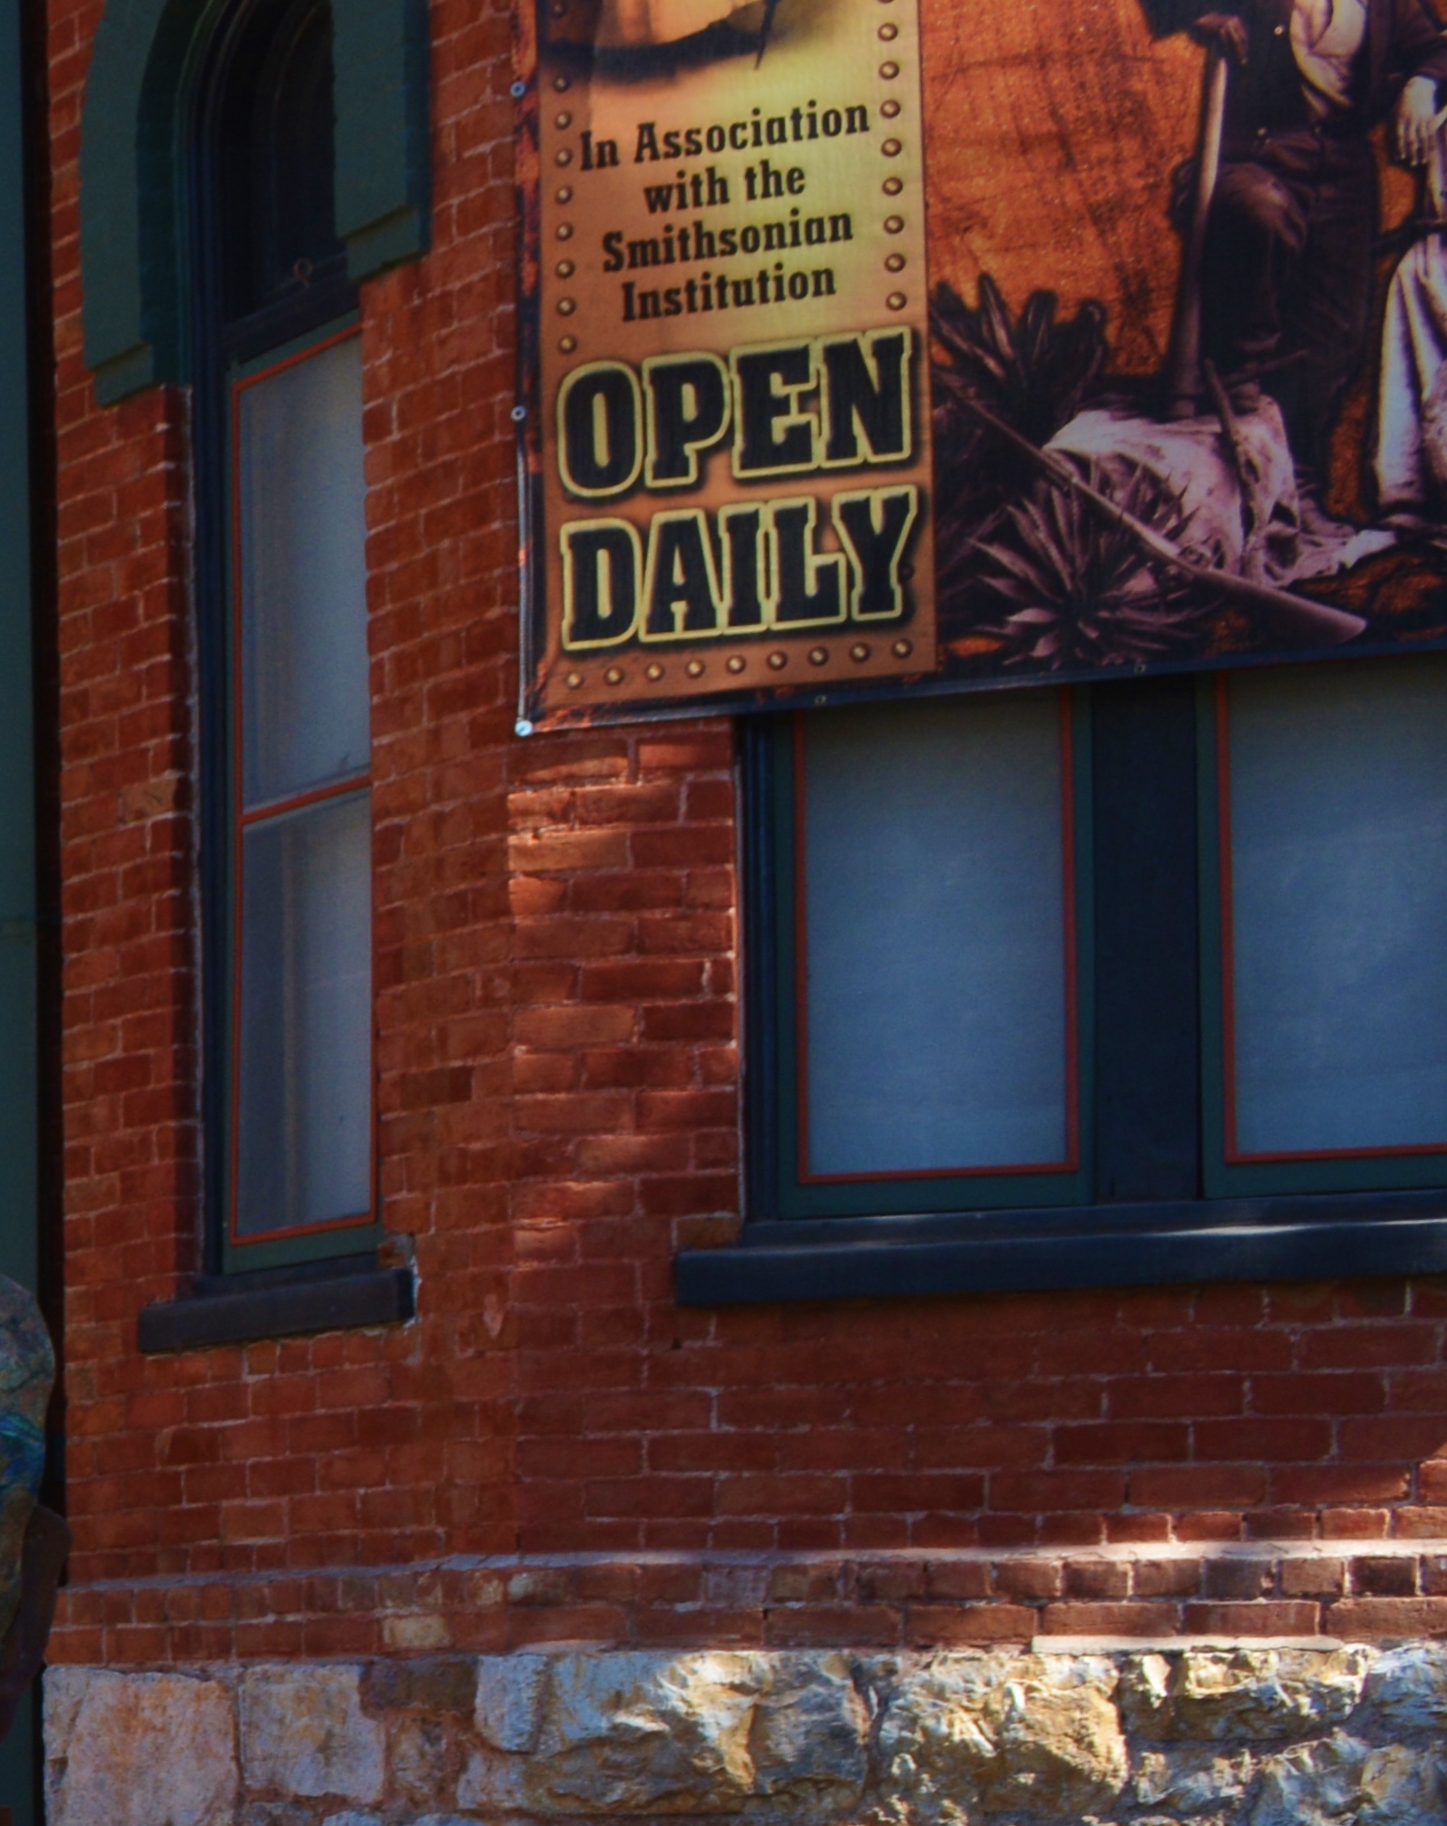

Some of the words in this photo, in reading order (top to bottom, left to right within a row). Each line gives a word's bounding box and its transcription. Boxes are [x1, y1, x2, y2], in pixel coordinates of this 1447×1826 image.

[579, 131, 620, 172] In
[633, 99, 870, 164] Association
[643, 166, 731, 214] with
[744, 159, 806, 202] the
[602, 206, 854, 273] Smithsonian
[621, 262, 837, 323] Institution
[557, 326, 914, 498] OPEN
[560, 485, 918, 653] DAILY
